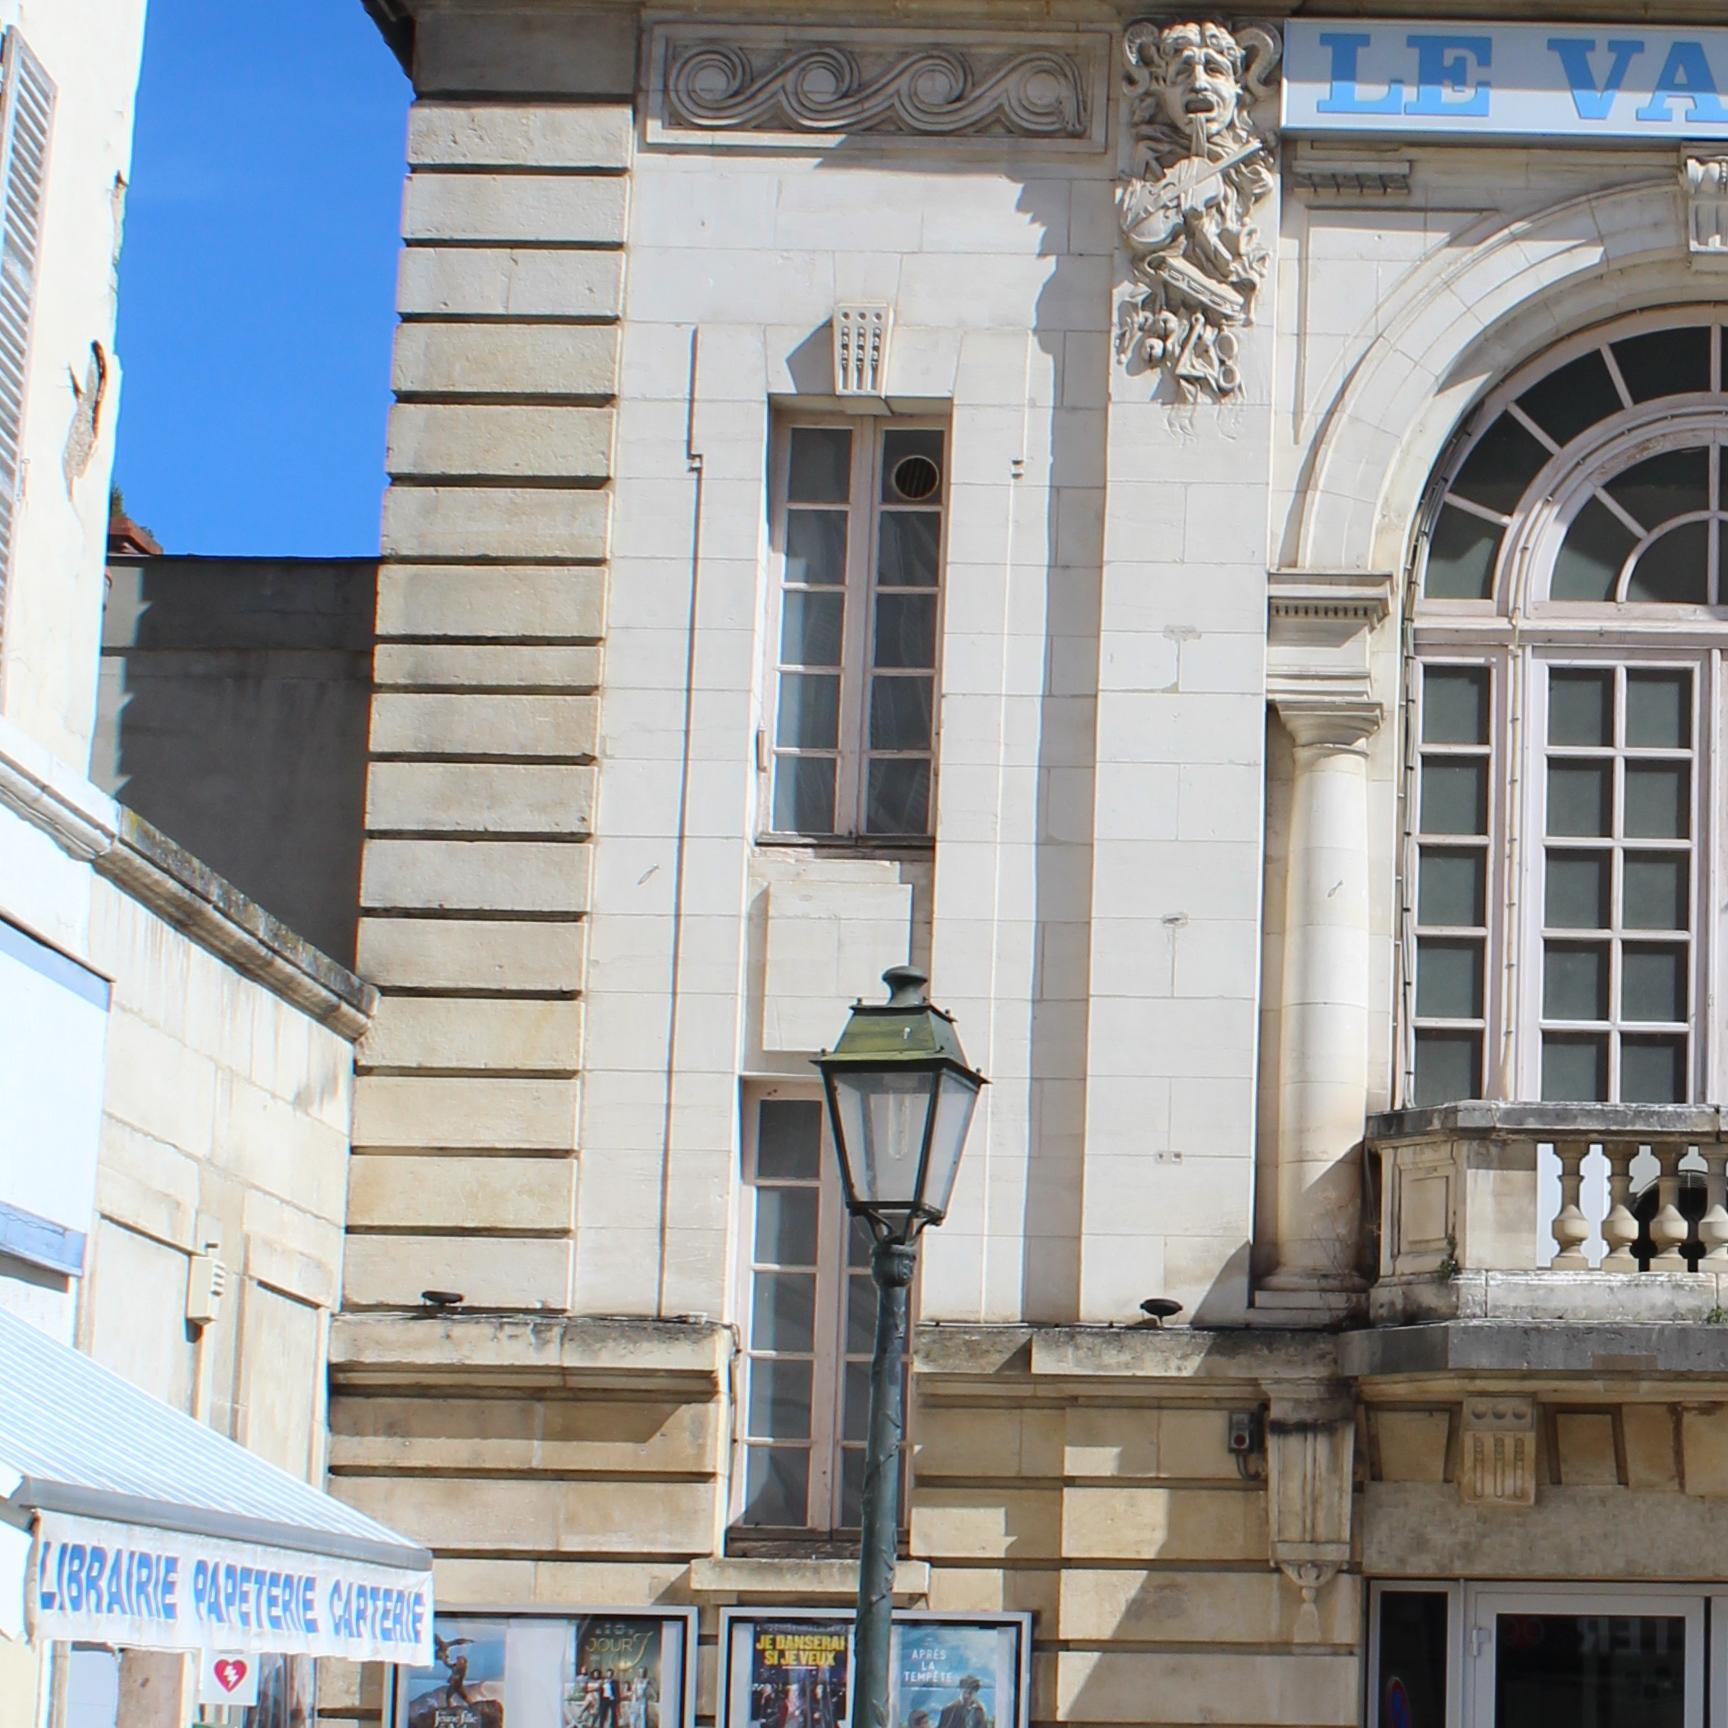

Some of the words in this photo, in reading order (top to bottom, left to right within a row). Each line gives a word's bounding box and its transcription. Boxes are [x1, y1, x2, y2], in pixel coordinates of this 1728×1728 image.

[1315, 32, 1494, 118] LE
[39, 1540, 180, 1621] LIBRAIRIE
[193, 1557, 320, 1636] PAPETERIE
[328, 1578, 426, 1645] CARTERIE
[585, 1637, 633, 1653] JOUR
[757, 1635, 774, 1650] JE
[776, 1635, 846, 1651] DANSERAI
[764, 1651, 779, 1666] SI
[780, 1651, 798, 1666] JE
[799, 1651, 836, 1667] VEUX
[921, 1660, 936, 1671] LA
